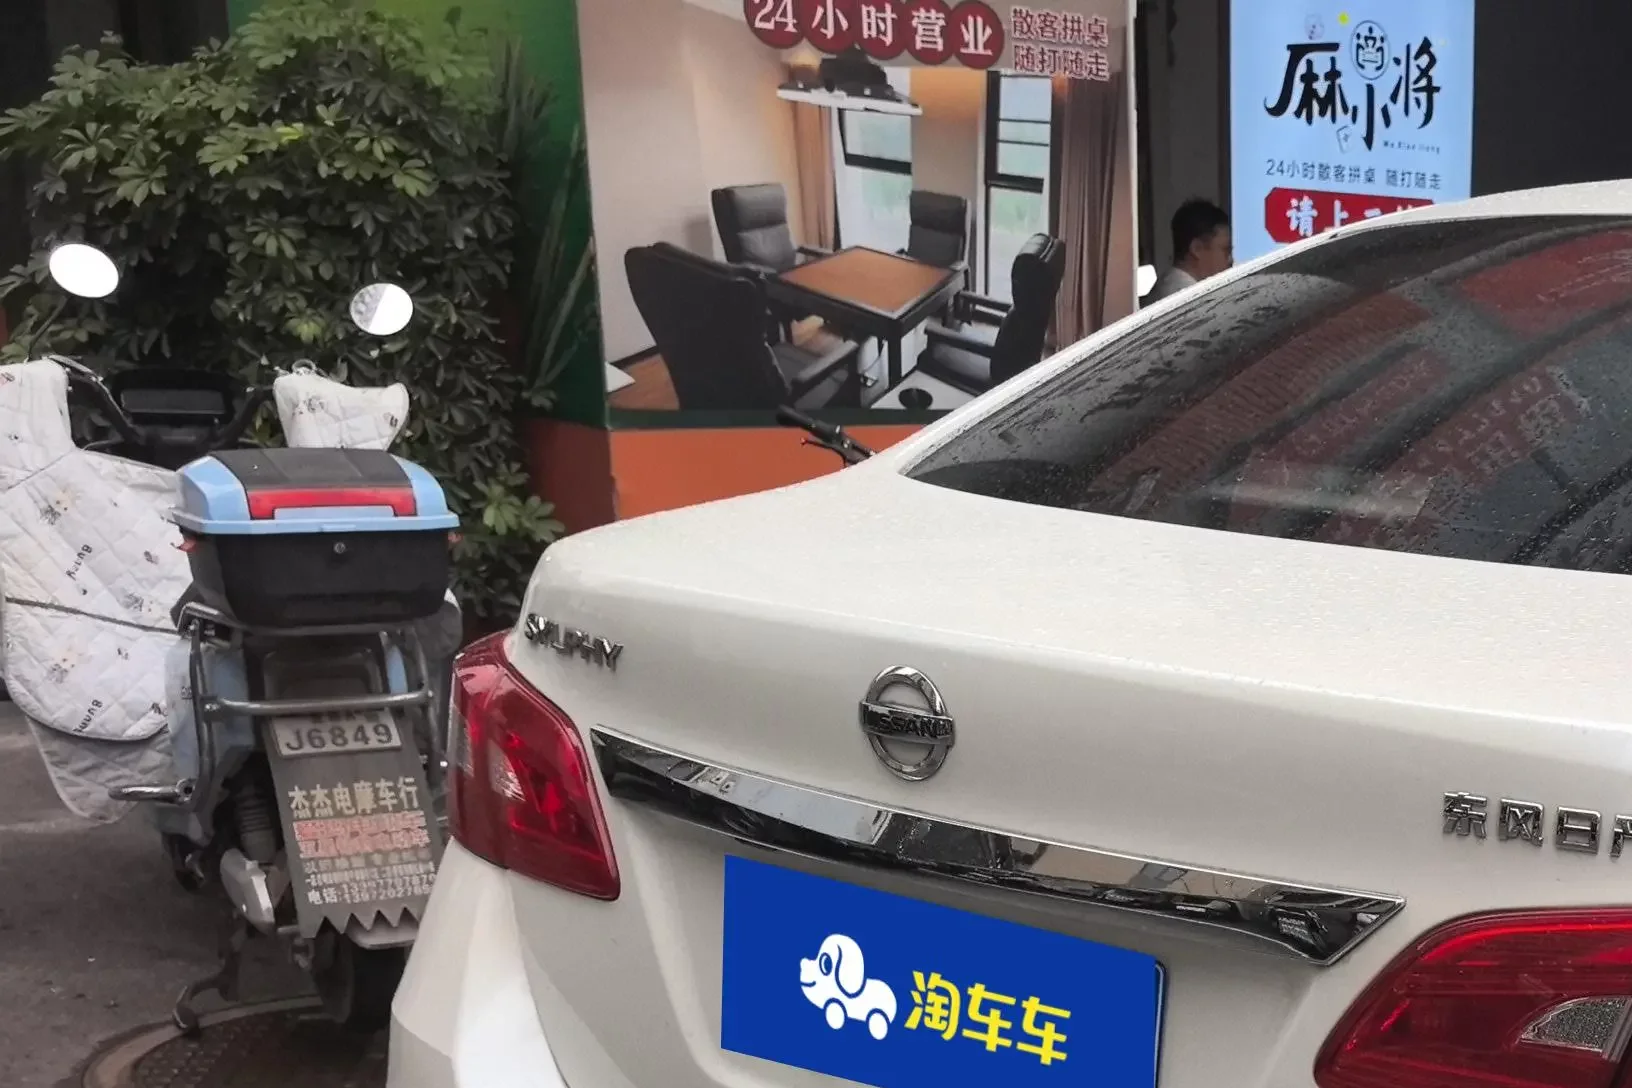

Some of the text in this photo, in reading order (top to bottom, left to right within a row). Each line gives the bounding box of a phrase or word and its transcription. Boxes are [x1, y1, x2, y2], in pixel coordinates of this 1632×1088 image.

[745, 0, 993, 57] 24小时营业
[1011, 7, 1110, 48] 散客拼桌
[1013, 44, 1111, 82] 随打随走
[1265, 158, 1376, 187] 24小时散客拼桌
[1285, 195, 1416, 238] 请上
[525, 613, 624, 673] SYLPHY
[285, 723, 393, 751] J6849
[288, 776, 419, 819] 杰杰电摩车行
